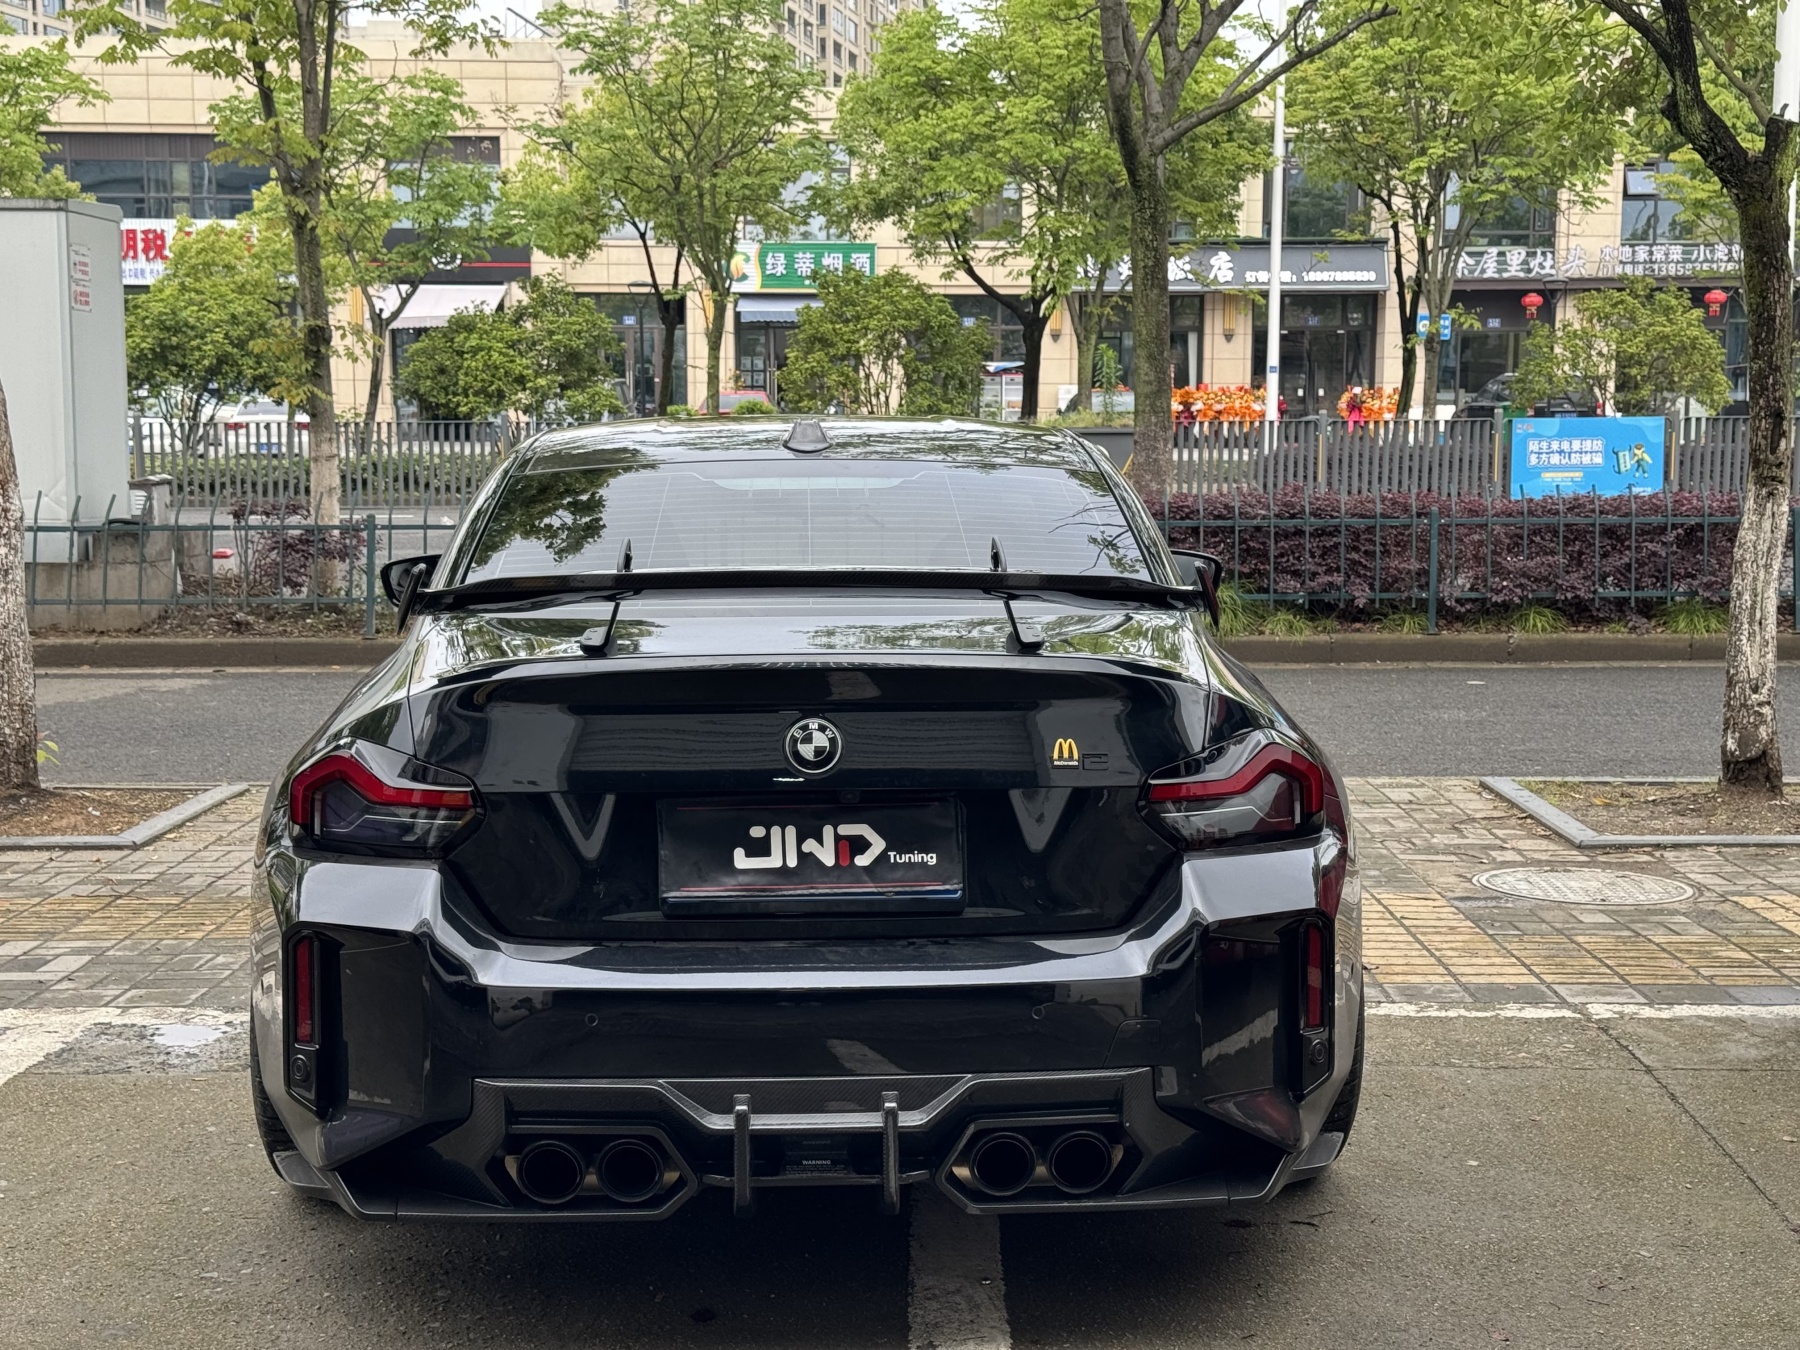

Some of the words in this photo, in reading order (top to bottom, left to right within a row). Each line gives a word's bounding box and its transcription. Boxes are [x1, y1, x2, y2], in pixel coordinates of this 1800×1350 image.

[1600, 244, 1683, 262] 本地家常菜
[765, 252, 871, 277] 绿蒂烟酒
[793, 722, 835, 738] BMW
[887, 851, 937, 865] Tuning
